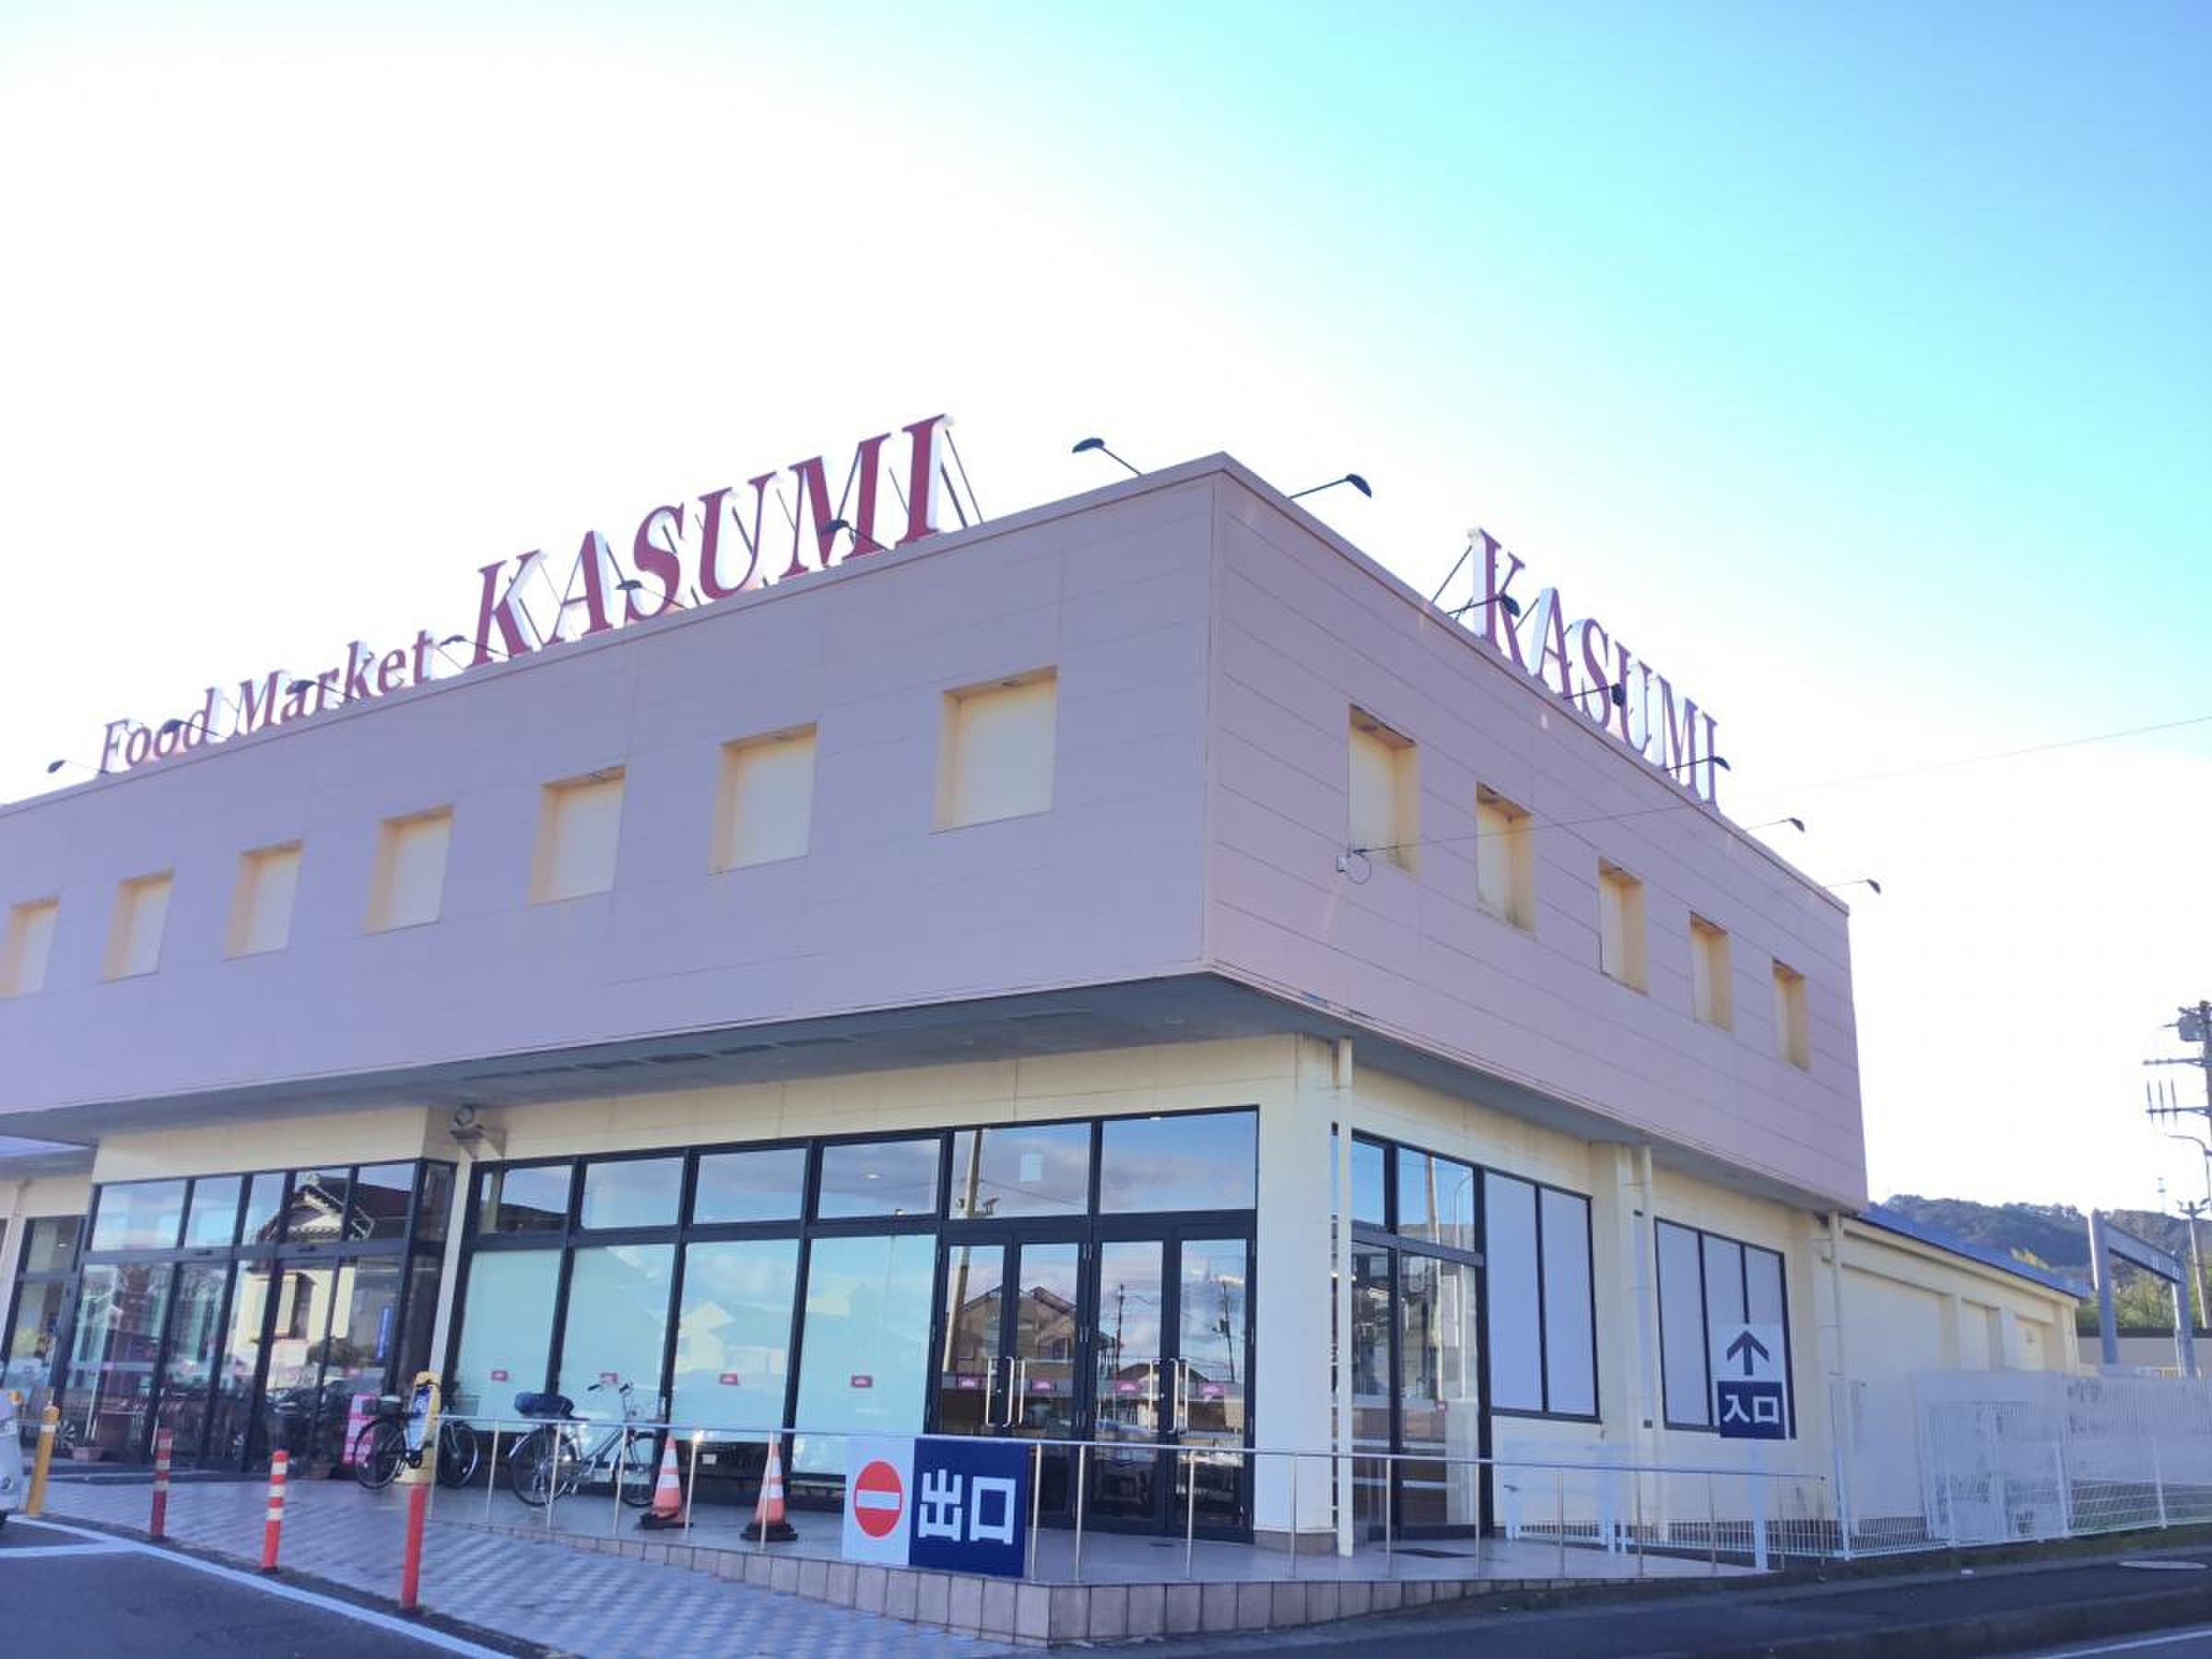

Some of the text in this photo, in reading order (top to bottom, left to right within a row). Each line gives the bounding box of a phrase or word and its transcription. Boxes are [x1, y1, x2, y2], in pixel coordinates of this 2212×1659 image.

[99, 412, 953, 773] Food Market KASUMI
[1471, 527, 1720, 815] KASUMI
[1723, 1394, 1780, 1425] 入口
[918, 1468, 1017, 1546] 出口
